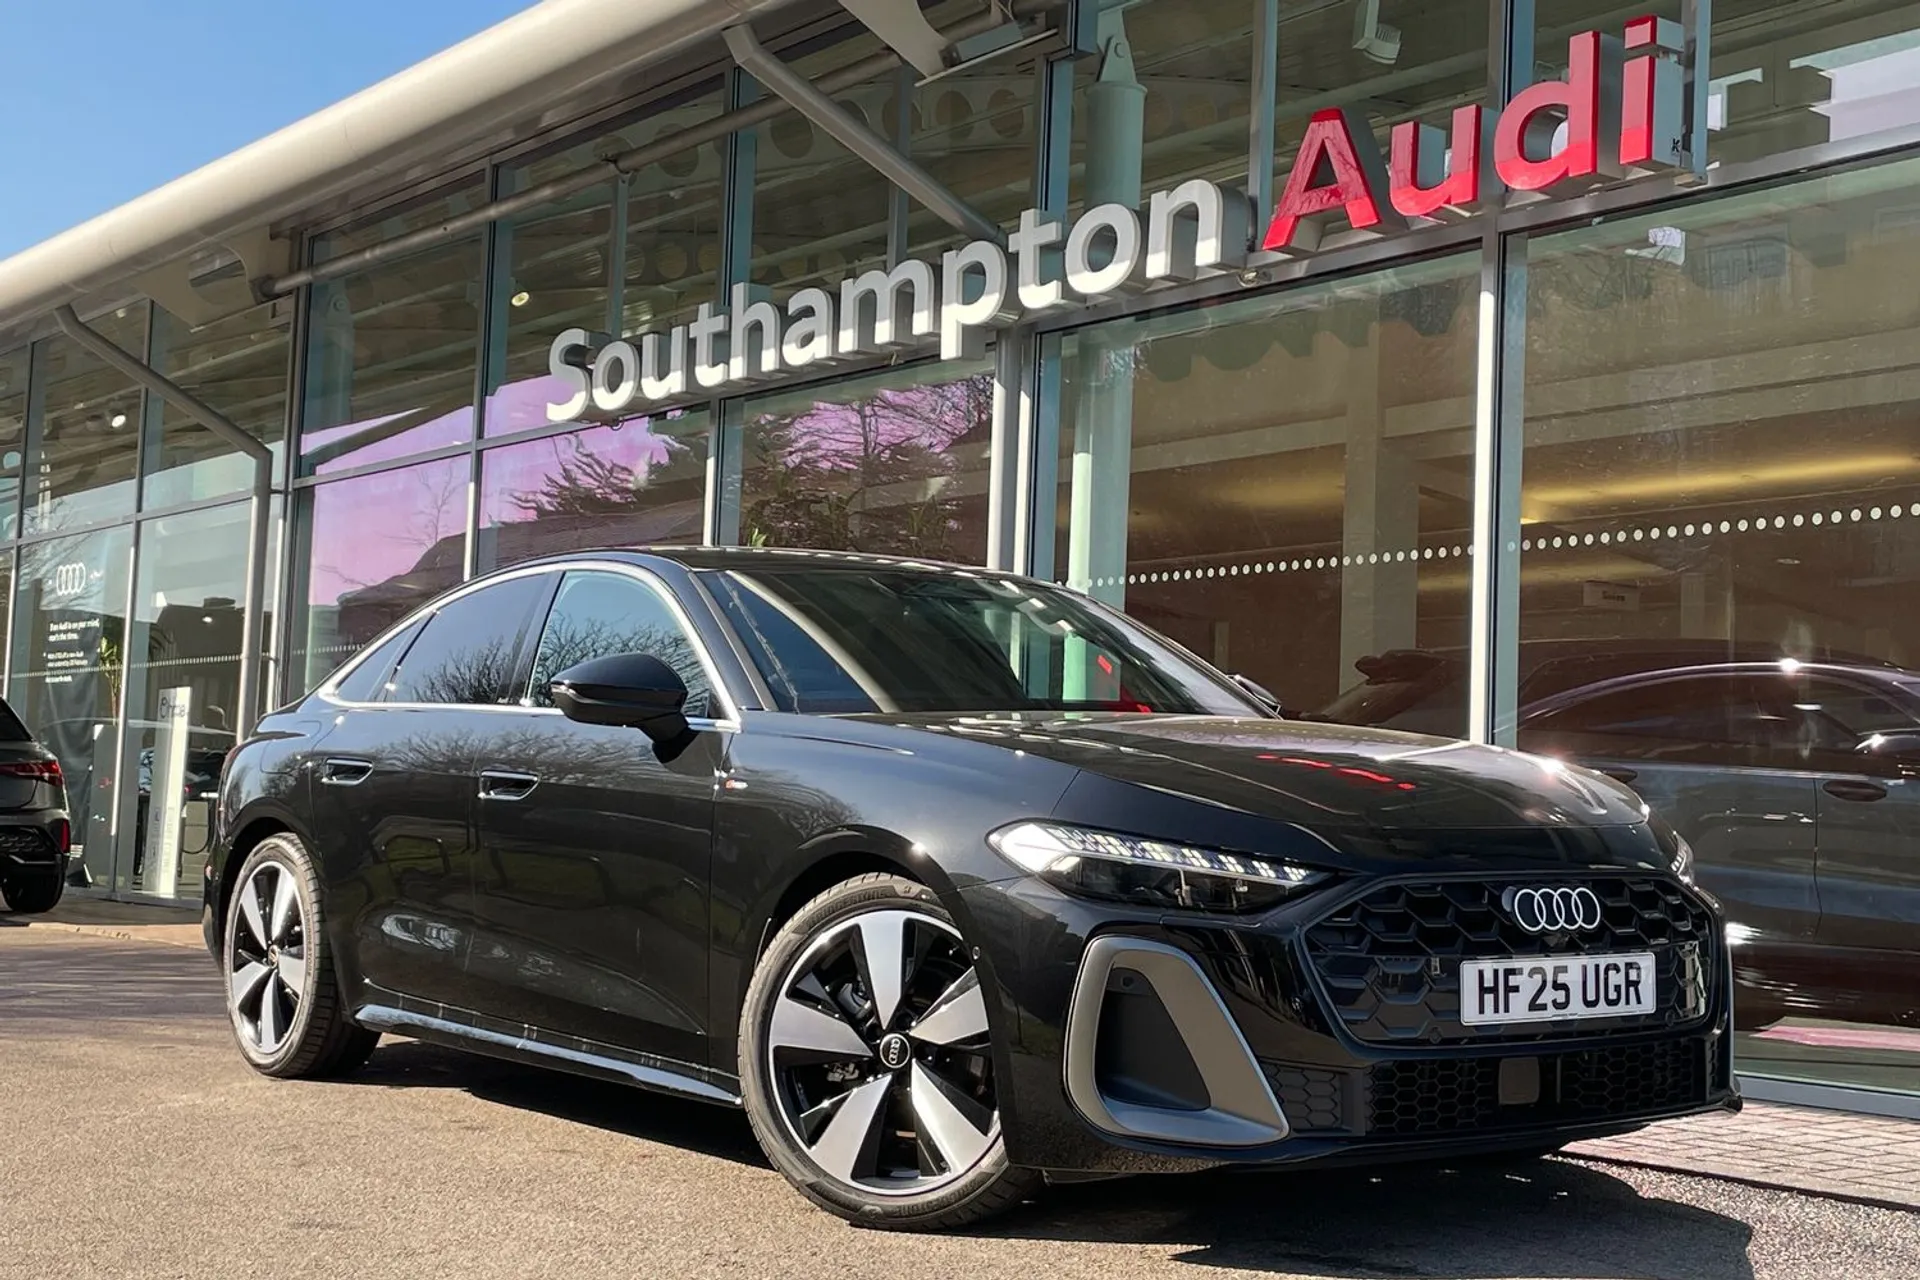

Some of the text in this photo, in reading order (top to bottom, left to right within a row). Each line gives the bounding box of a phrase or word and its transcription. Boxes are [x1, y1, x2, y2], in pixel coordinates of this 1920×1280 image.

[546, 14, 1658, 422] Southampton Audi
[1477, 962, 1642, 1015] HF25 UGR
